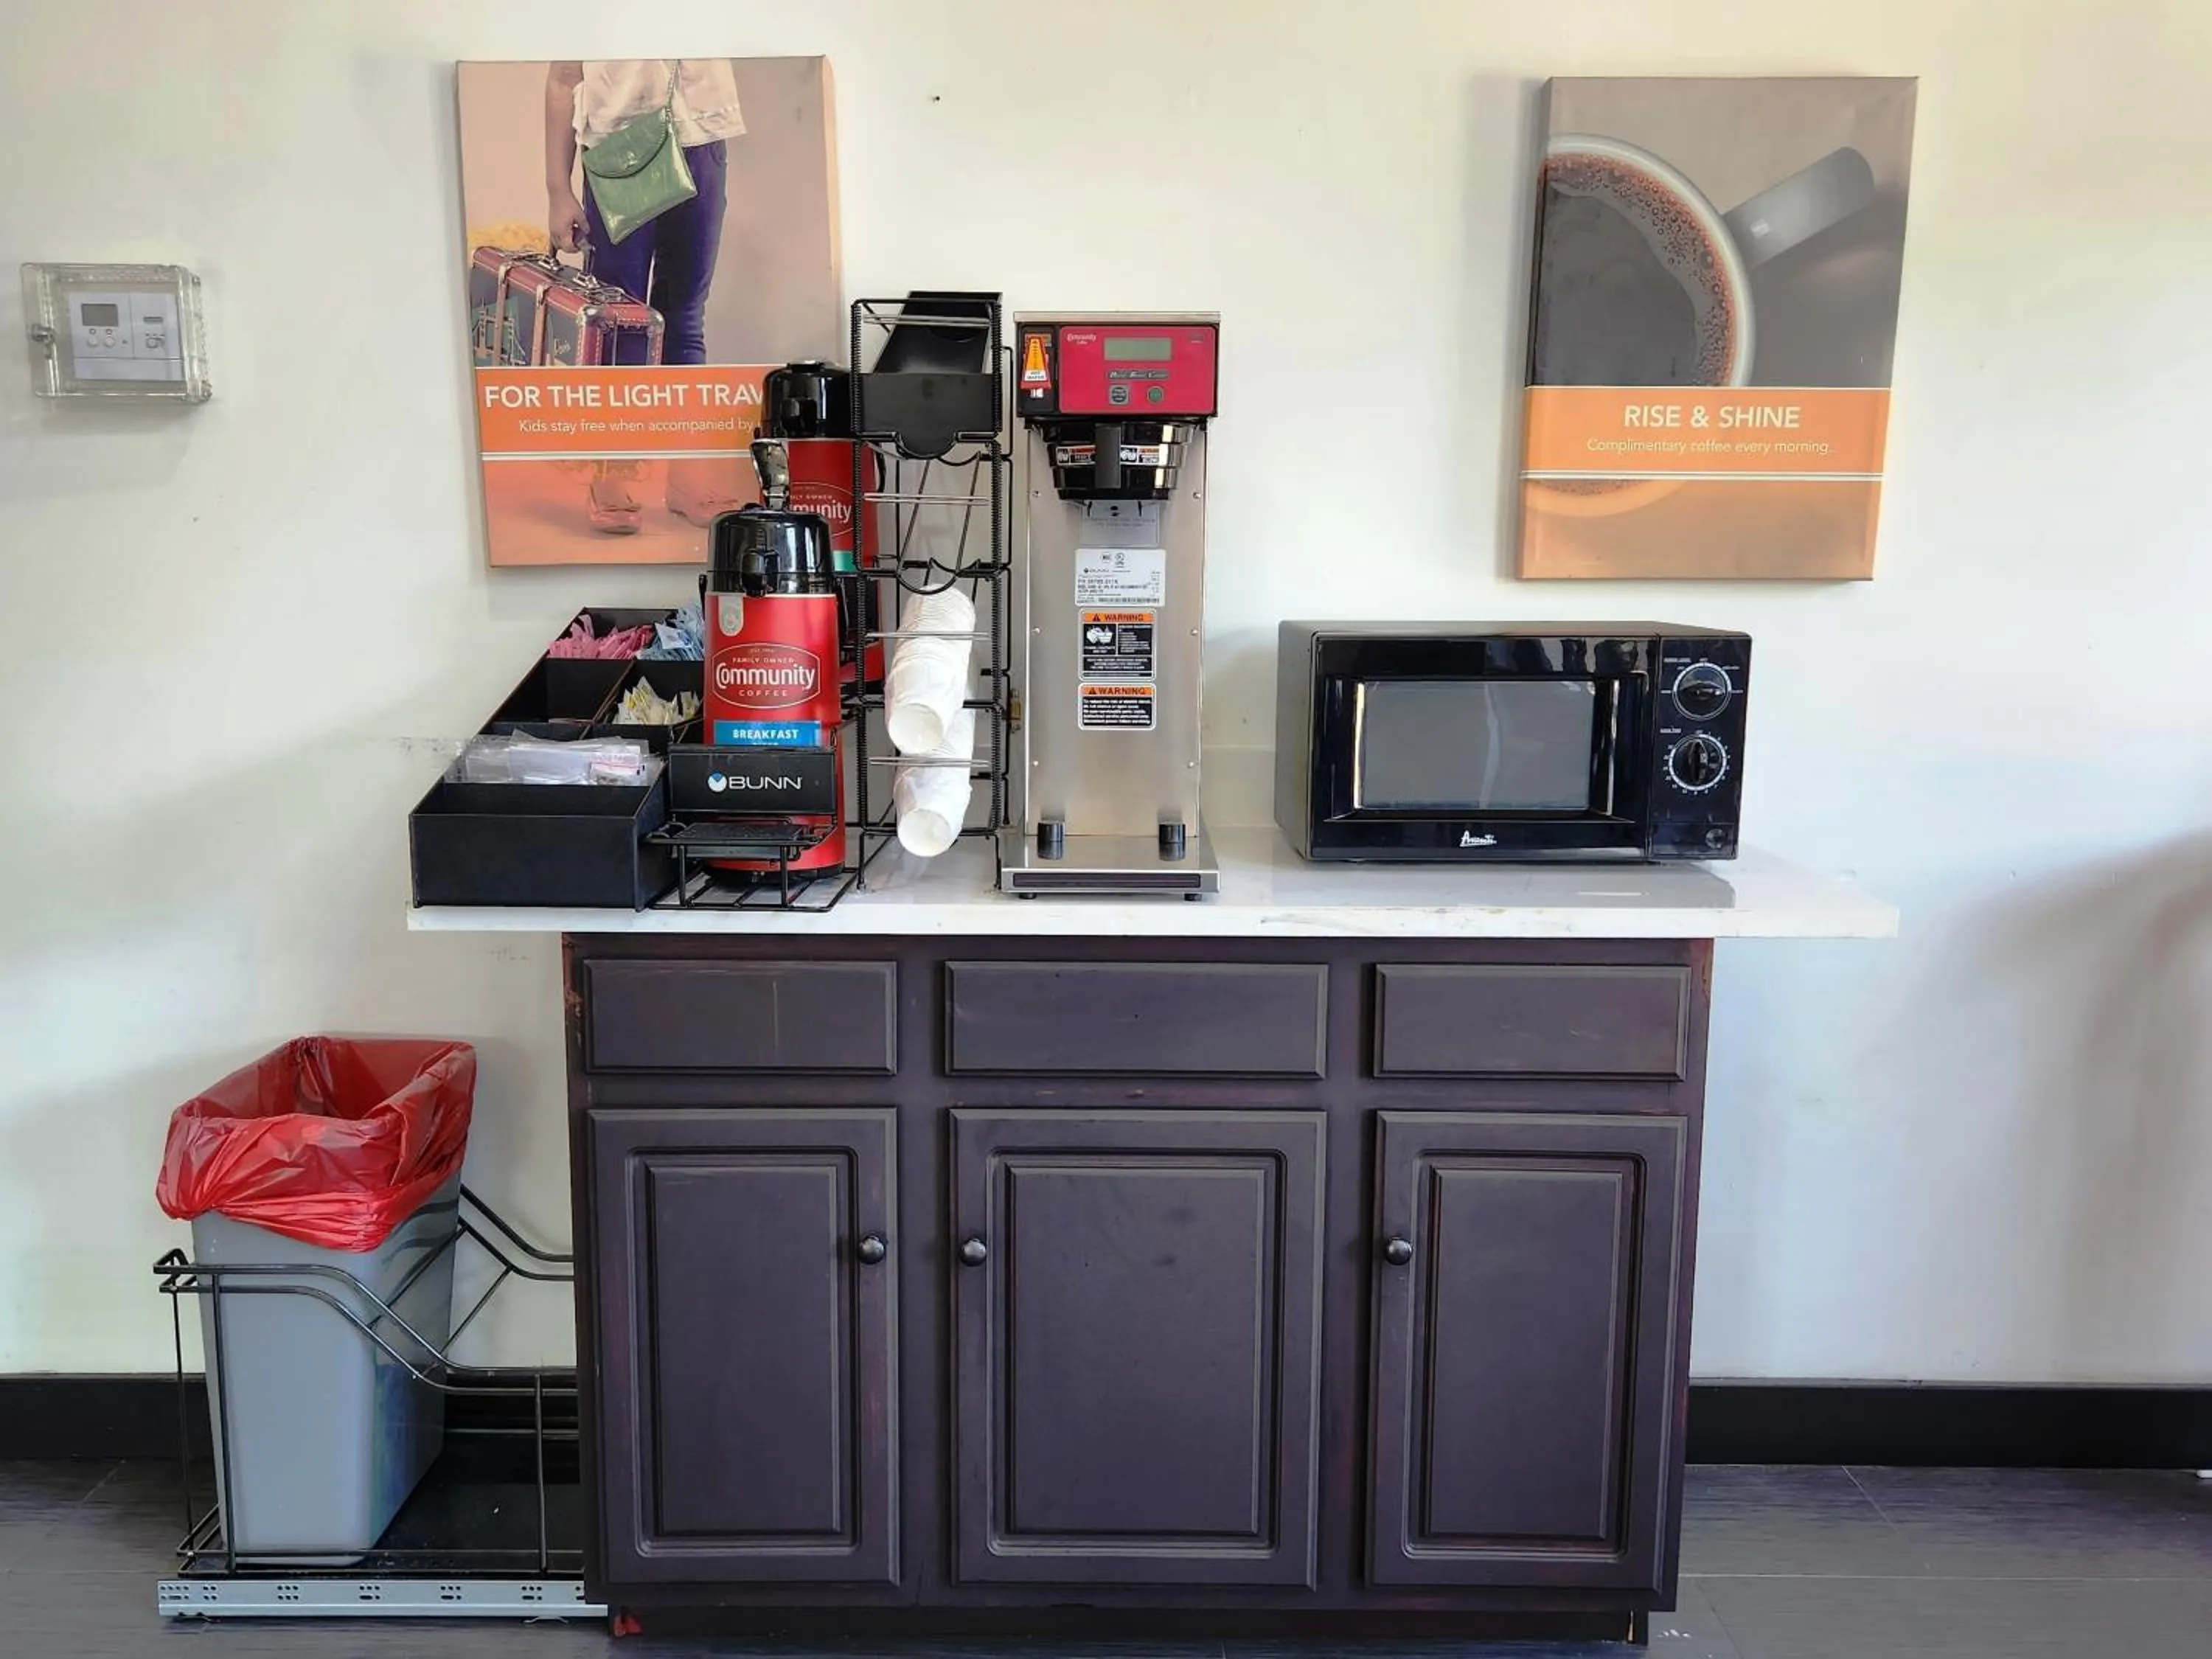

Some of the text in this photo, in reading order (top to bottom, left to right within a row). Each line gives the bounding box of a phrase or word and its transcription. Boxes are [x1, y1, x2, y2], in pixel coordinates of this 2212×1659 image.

[484, 383, 764, 408] FOR THE LIGHT TRAV
[1624, 405, 1801, 428] RISE & SHINE
[518, 418, 547, 431] Kids
[552, 420, 577, 434] stay
[580, 418, 606, 431] free
[610, 418, 644, 431] when
[648, 417, 734, 434] accompanied
[737, 417, 754, 432] by
[1587, 438, 1686, 454] Complimentary
[1690, 439, 1731, 452] coffee
[1735, 442, 1770, 455] every
[790, 499, 852, 524] munity
[1105, 613, 1144, 622] WARNING
[716, 662, 815, 690] Community
[1098, 686, 1146, 695] WARNING
[732, 728, 799, 740] BREAKFAST
[728, 776, 802, 790] BUNN
